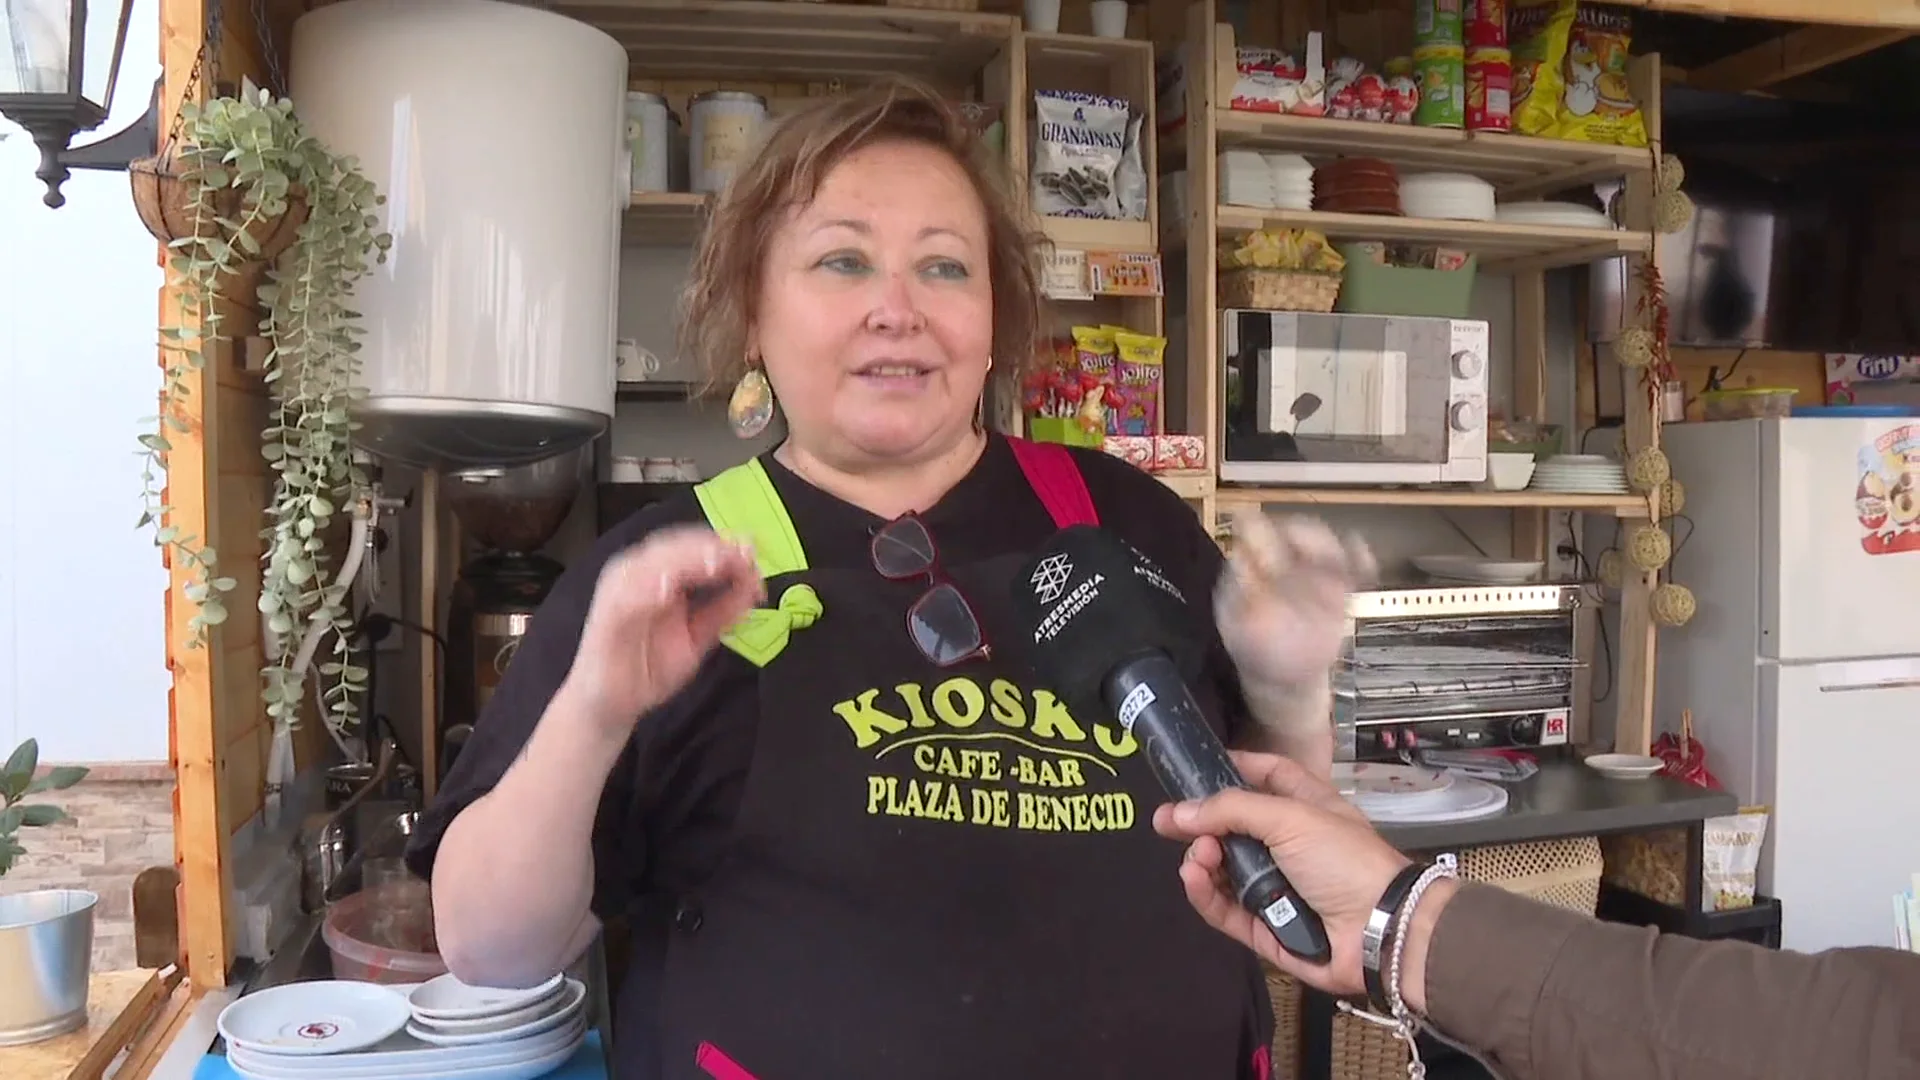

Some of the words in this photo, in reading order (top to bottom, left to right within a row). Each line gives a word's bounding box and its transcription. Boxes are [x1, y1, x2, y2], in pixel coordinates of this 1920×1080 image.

[1034, 573, 1105, 643] ATRESMEDIA
[1121, 689, 1150, 726] G272
[914, 745, 1002, 780] CAFE
[867, 776, 965, 822] PLAZA
[972, 789, 1012, 828] DE
[1018, 793, 1136, 832] BENECID
